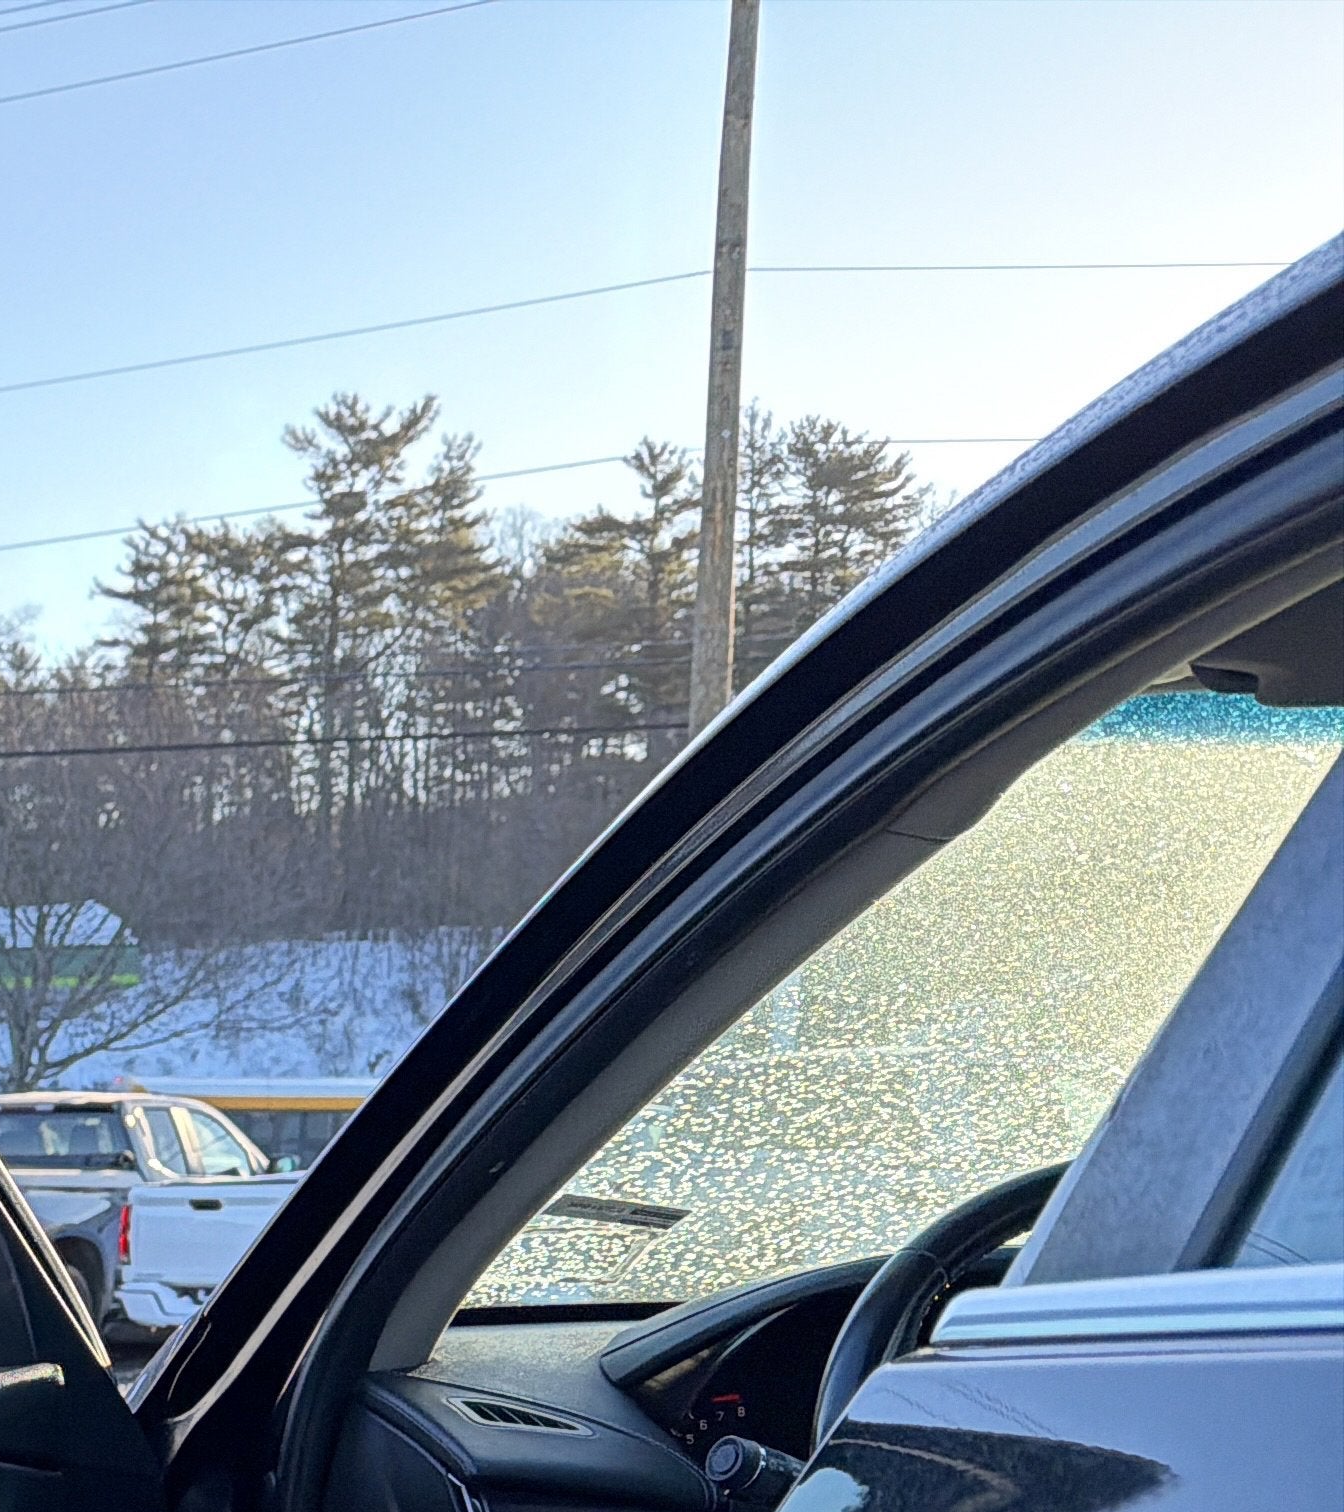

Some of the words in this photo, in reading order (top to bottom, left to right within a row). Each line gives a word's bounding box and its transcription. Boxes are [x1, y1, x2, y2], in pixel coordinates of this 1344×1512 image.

[716, 1411, 725, 1421] 7
[737, 1406, 746, 1418] 8
[699, 1419, 708, 1431] 6
[686, 1434, 695, 1445] 5
